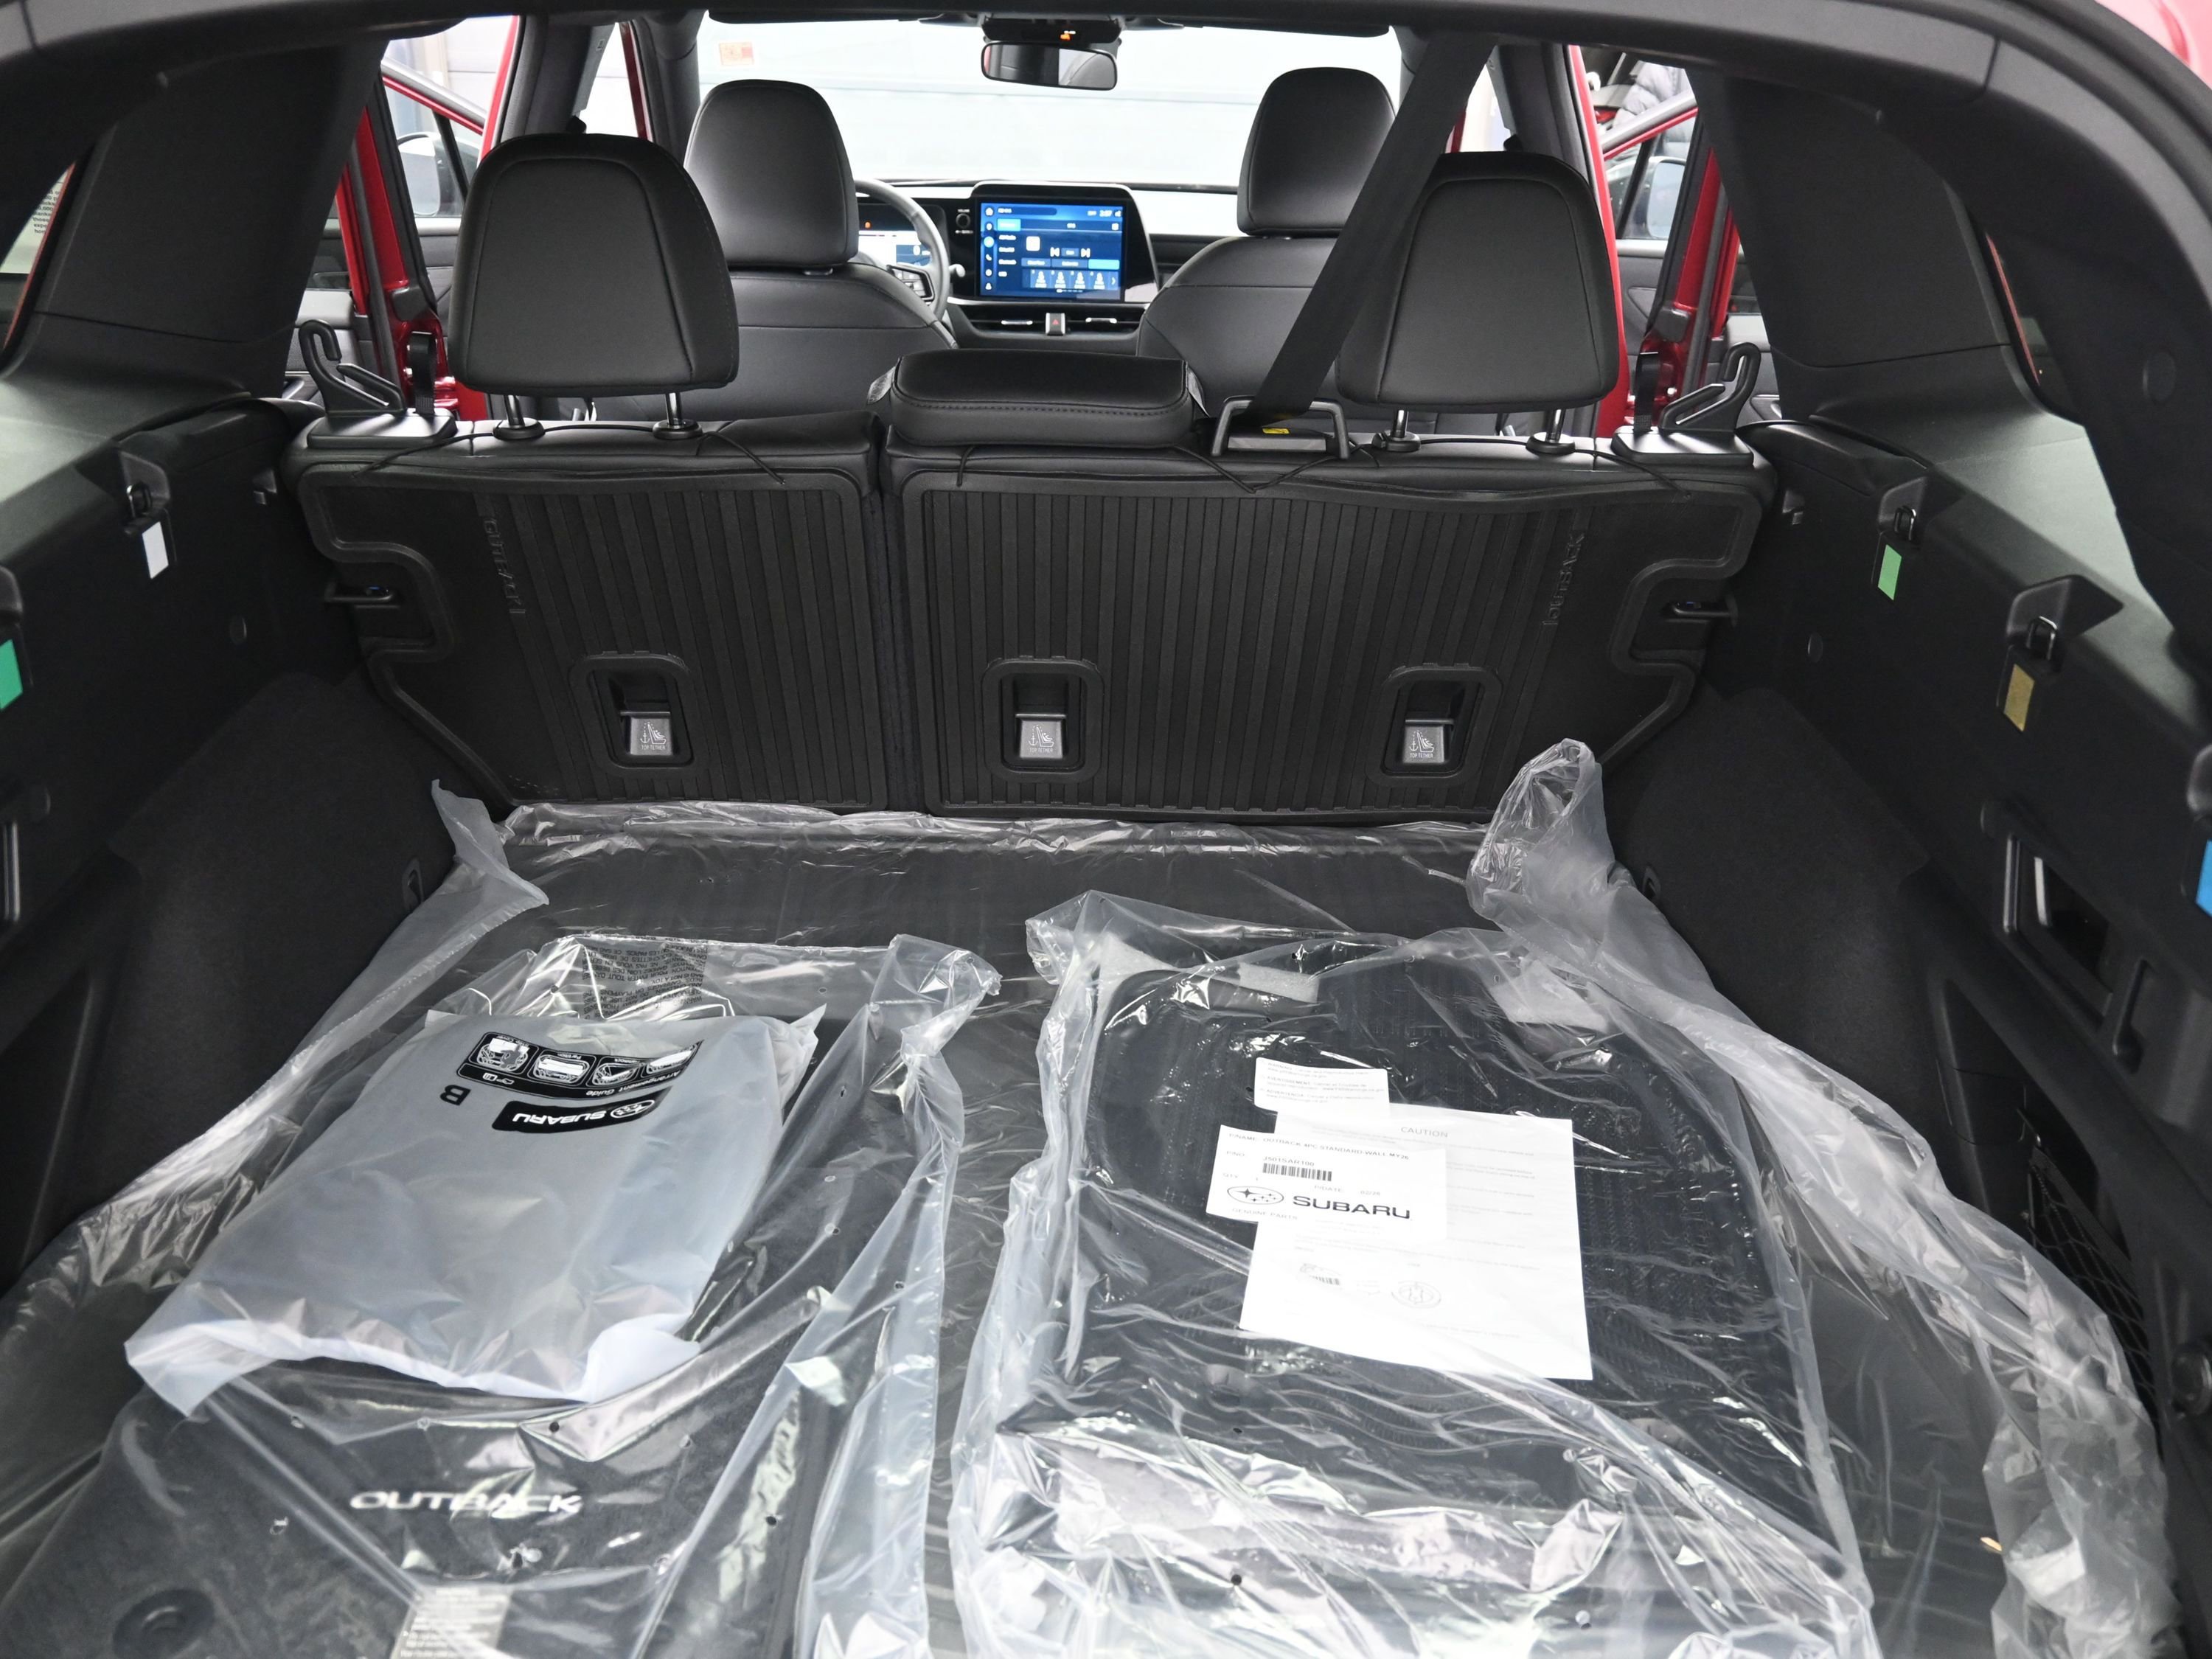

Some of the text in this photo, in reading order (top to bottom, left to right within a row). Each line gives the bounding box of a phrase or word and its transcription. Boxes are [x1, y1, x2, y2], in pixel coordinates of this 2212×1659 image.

[608, 973, 625, 981] TOUT
[557, 1052, 582, 1060] Partition
[585, 1069, 680, 1096] Arrangement Guide
[439, 1085, 471, 1106] B
[512, 1110, 607, 1125] SUBARU
[1400, 1127, 1448, 1138] CAUTION
[1262, 1138, 1301, 1146] OUTBACK
[1292, 1194, 1411, 1220] SUBARU
[1270, 1212, 1298, 1220] PARTS
[349, 1491, 582, 1513] OUTBACK
